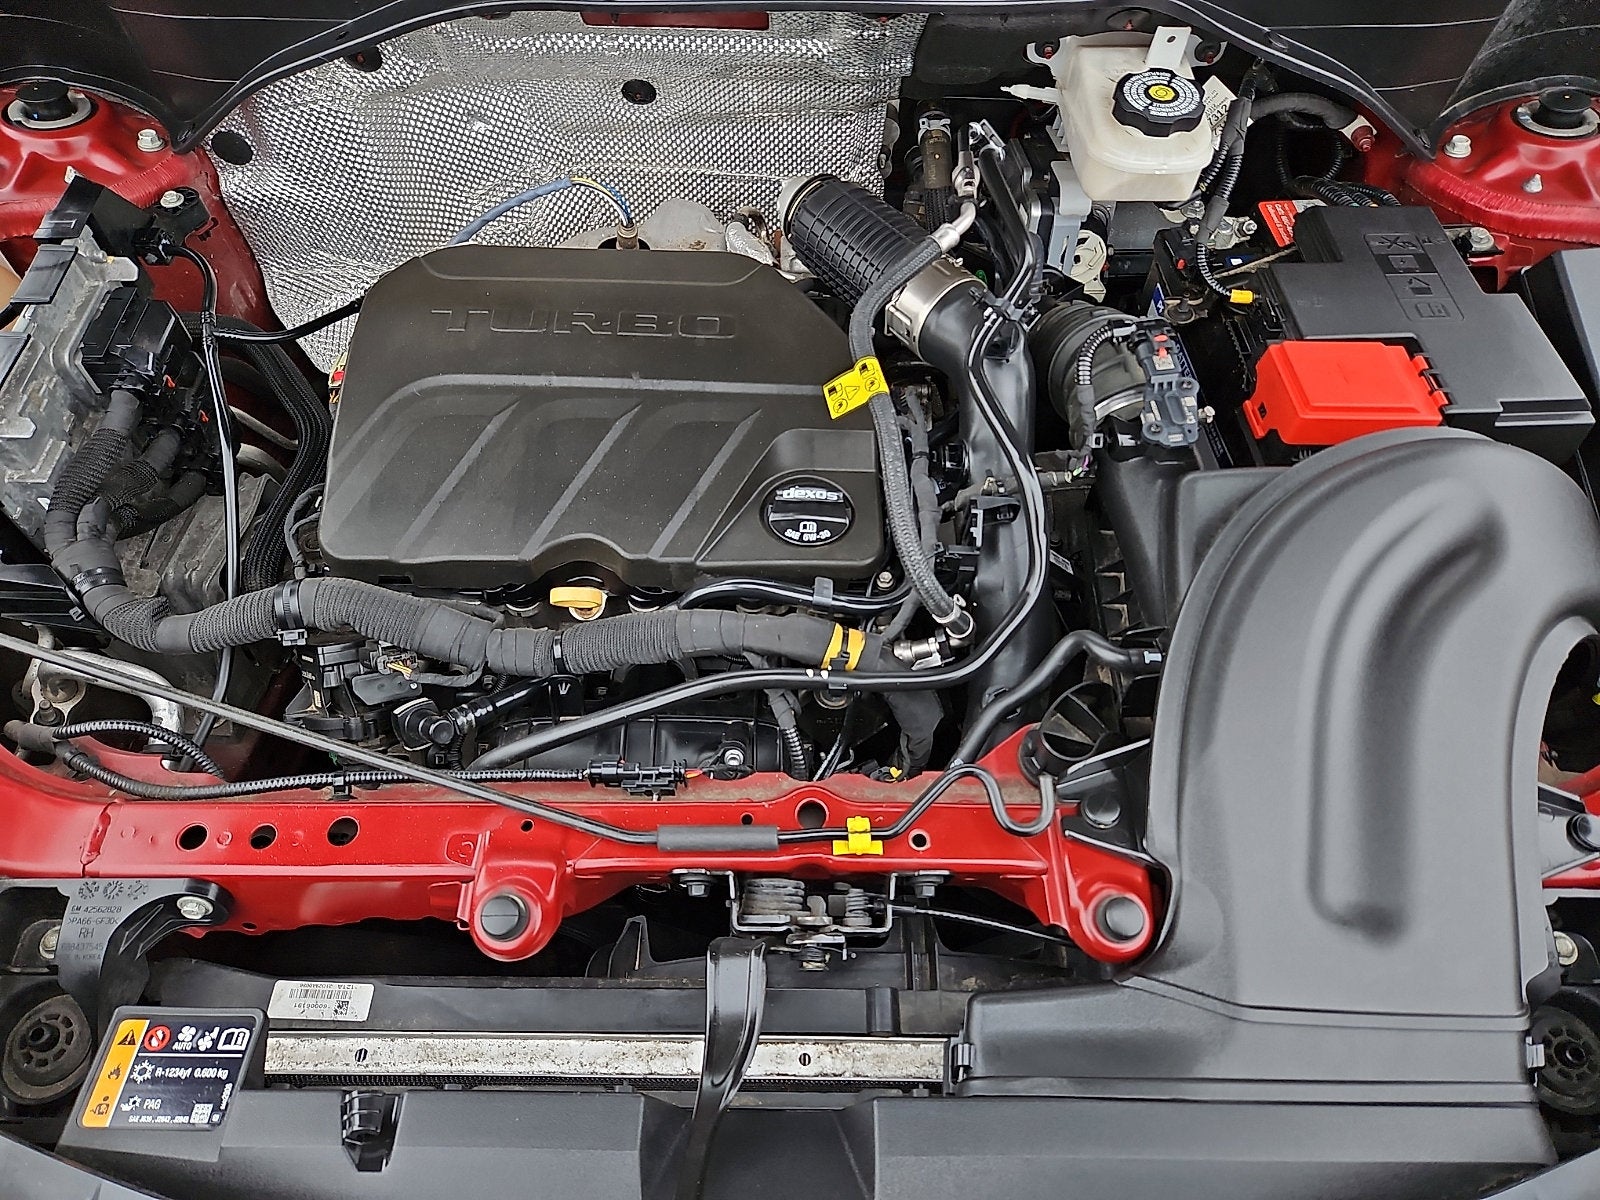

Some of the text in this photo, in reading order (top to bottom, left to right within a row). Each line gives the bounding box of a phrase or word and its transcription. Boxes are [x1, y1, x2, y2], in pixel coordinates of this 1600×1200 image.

[431, 308, 735, 339] TURBO
[78, 927, 95, 938] RH
[172, 1041, 193, 1051] AUTO
[194, 1067, 217, 1078] 0.600
[217, 1067, 229, 1080] kg
[143, 1099, 161, 1110] PAG
